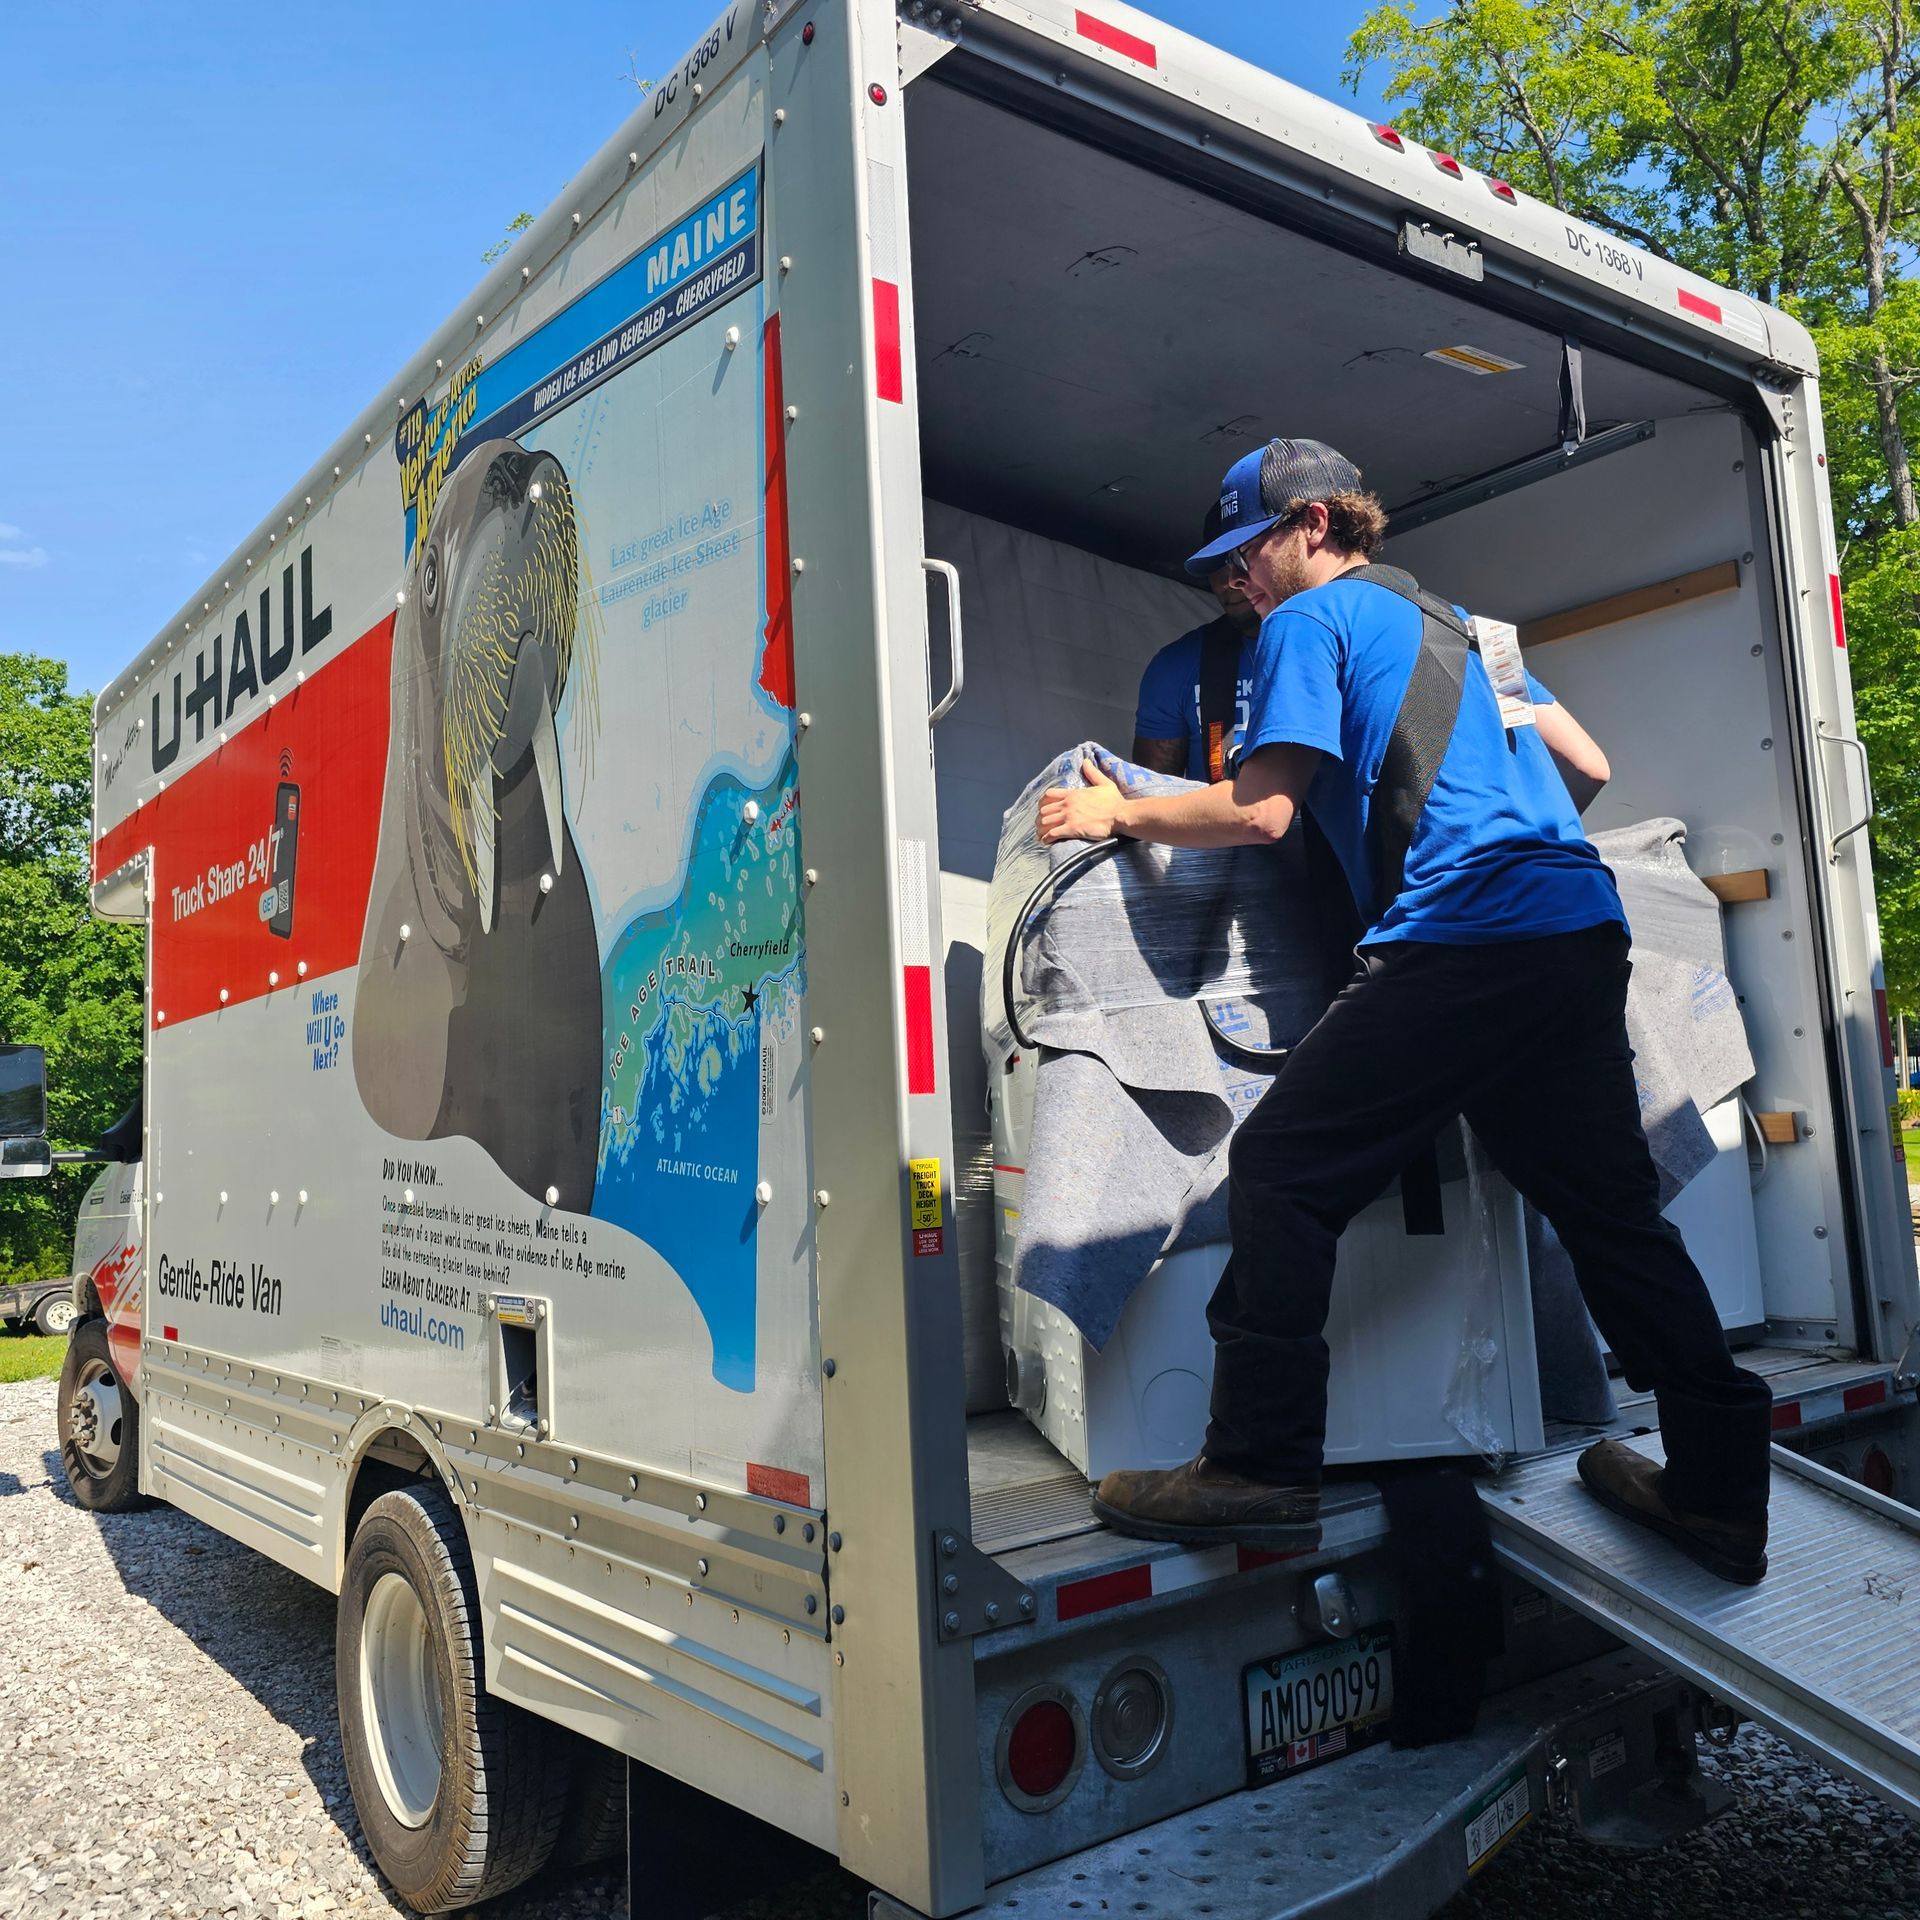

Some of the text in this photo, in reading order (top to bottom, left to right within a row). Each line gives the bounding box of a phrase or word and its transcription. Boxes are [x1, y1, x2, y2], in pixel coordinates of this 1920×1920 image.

[655, 6, 738, 119] DC 1368 V
[647, 188, 746, 294] MAINE
[1565, 226, 1643, 281] DC 1368 V
[534, 376, 562, 413] HIDDEN
[562, 365, 577, 393] ICE
[578, 353, 595, 381] AGE
[595, 338, 618, 372] LAND
[619, 307, 665, 355] REVEALED
[675, 251, 746, 317] CHERRYFIELD
[399, 408, 422, 445] #119
[400, 397, 448, 511] Venture
[611, 502, 730, 568] Last great Ice Age
[672, 555, 692, 575] Ice
[696, 535, 738, 564] Sheet
[643, 591, 688, 628] glacier
[152, 544, 332, 774] U-HAUL
[171, 875, 204, 922] Truck
[207, 860, 245, 904] Share
[262, 894, 274, 914] GET
[730, 938, 789, 959] Cherryfield
[312, 990, 338, 1016] Where
[610, 957, 715, 1079] ICE AGE TRAIL
[306, 1015, 345, 1048] Will U Go
[656, 1158, 738, 1184] ATLANTIC OCEAN
[913, 1171, 937, 1180] FREIGHT
[916, 1181, 935, 1190] TRUCK
[915, 1199, 937, 1209] HEIGHT
[918, 1190, 934, 1199] DECK
[382, 1195, 396, 1213] Once
[425, 1201, 448, 1222] beneath
[450, 1205, 460, 1224] the
[462, 1207, 474, 1227] last
[476, 1213, 493, 1232] great
[495, 1213, 505, 1232] ice
[507, 1214, 532, 1240] sheets,
[536, 1219, 559, 1240] Maine
[562, 1223, 579, 1244] tells
[582, 1231, 587, 1245] a
[381, 1240, 511, 1285] life did the retreating glacier leave behind?
[382, 1220, 626, 1280] unique story of a past world unknown. What evidence of Ice Age marine
[158, 1253, 282, 1315] Gentle-Ride Van
[381, 1265, 401, 1292] LEARN
[402, 1270, 424, 1299] ABOUT
[426, 1277, 459, 1310] GLACIERS
[381, 1299, 464, 1351] uhaul.com
[1283, 1643, 1356, 1674] ARIZONA
[1261, 1655, 1380, 1750] AM09099
